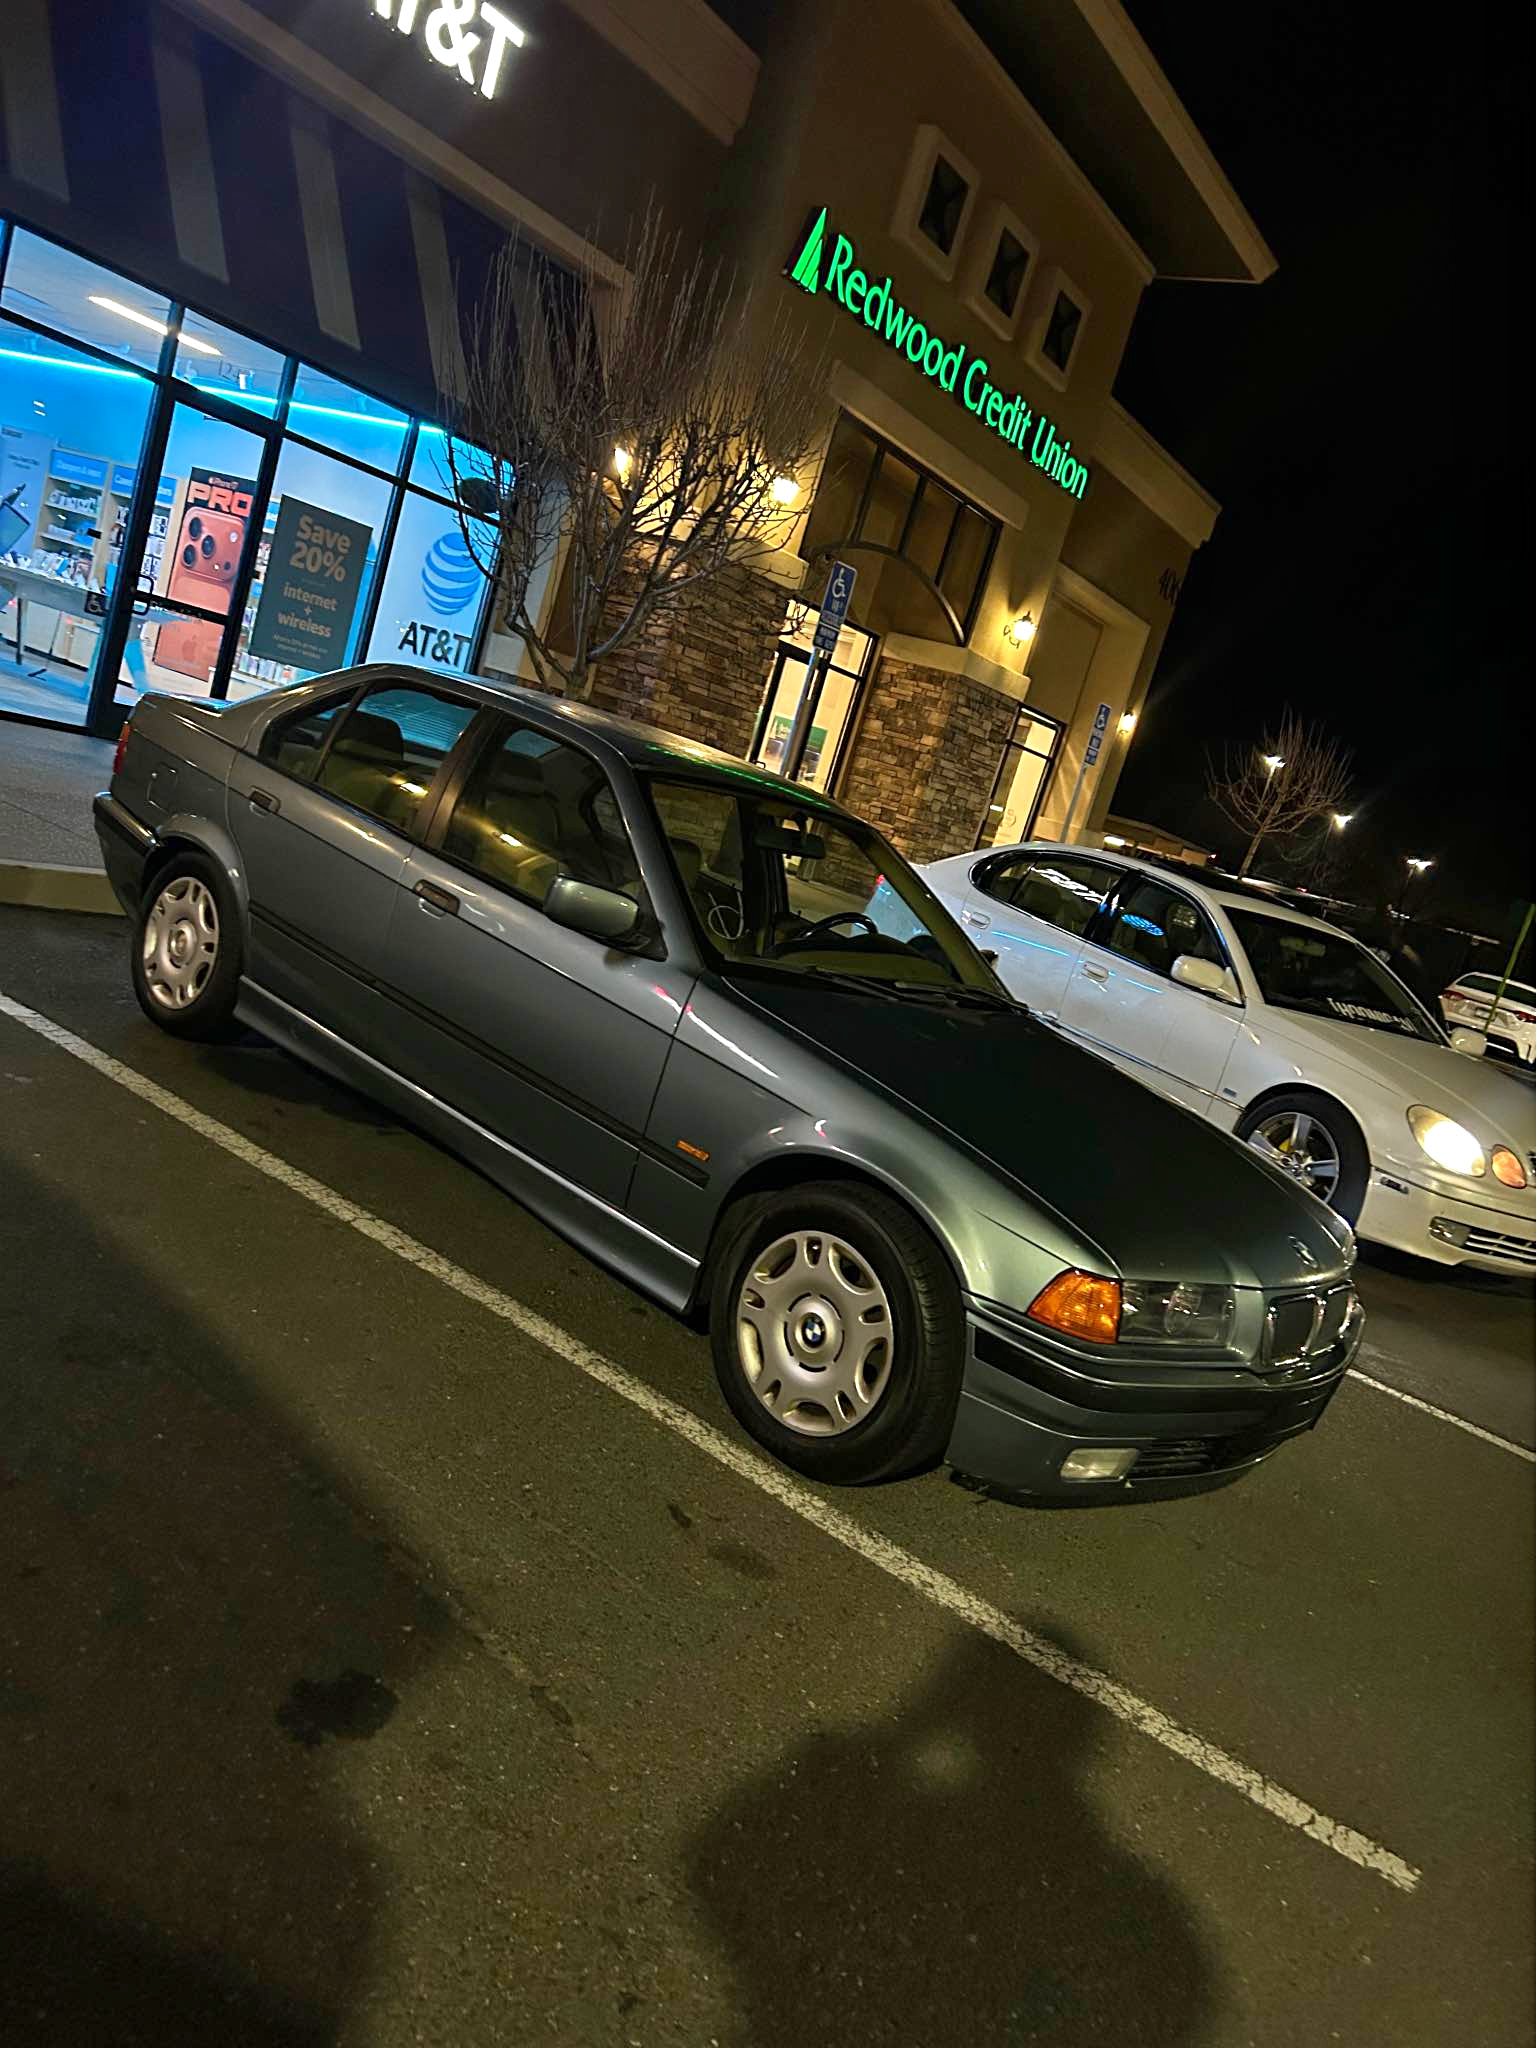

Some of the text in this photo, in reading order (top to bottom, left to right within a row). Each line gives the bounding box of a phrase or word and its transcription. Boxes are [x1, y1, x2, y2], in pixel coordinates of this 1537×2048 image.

[824, 233, 1089, 501] Redwood Credit Union
[187, 480, 254, 518] PRO
[297, 514, 352, 554] Save
[289, 540, 347, 582] 20%
[283, 582, 338, 612] internet
[277, 612, 333, 637] wireless
[398, 621, 472, 667] AT&T
